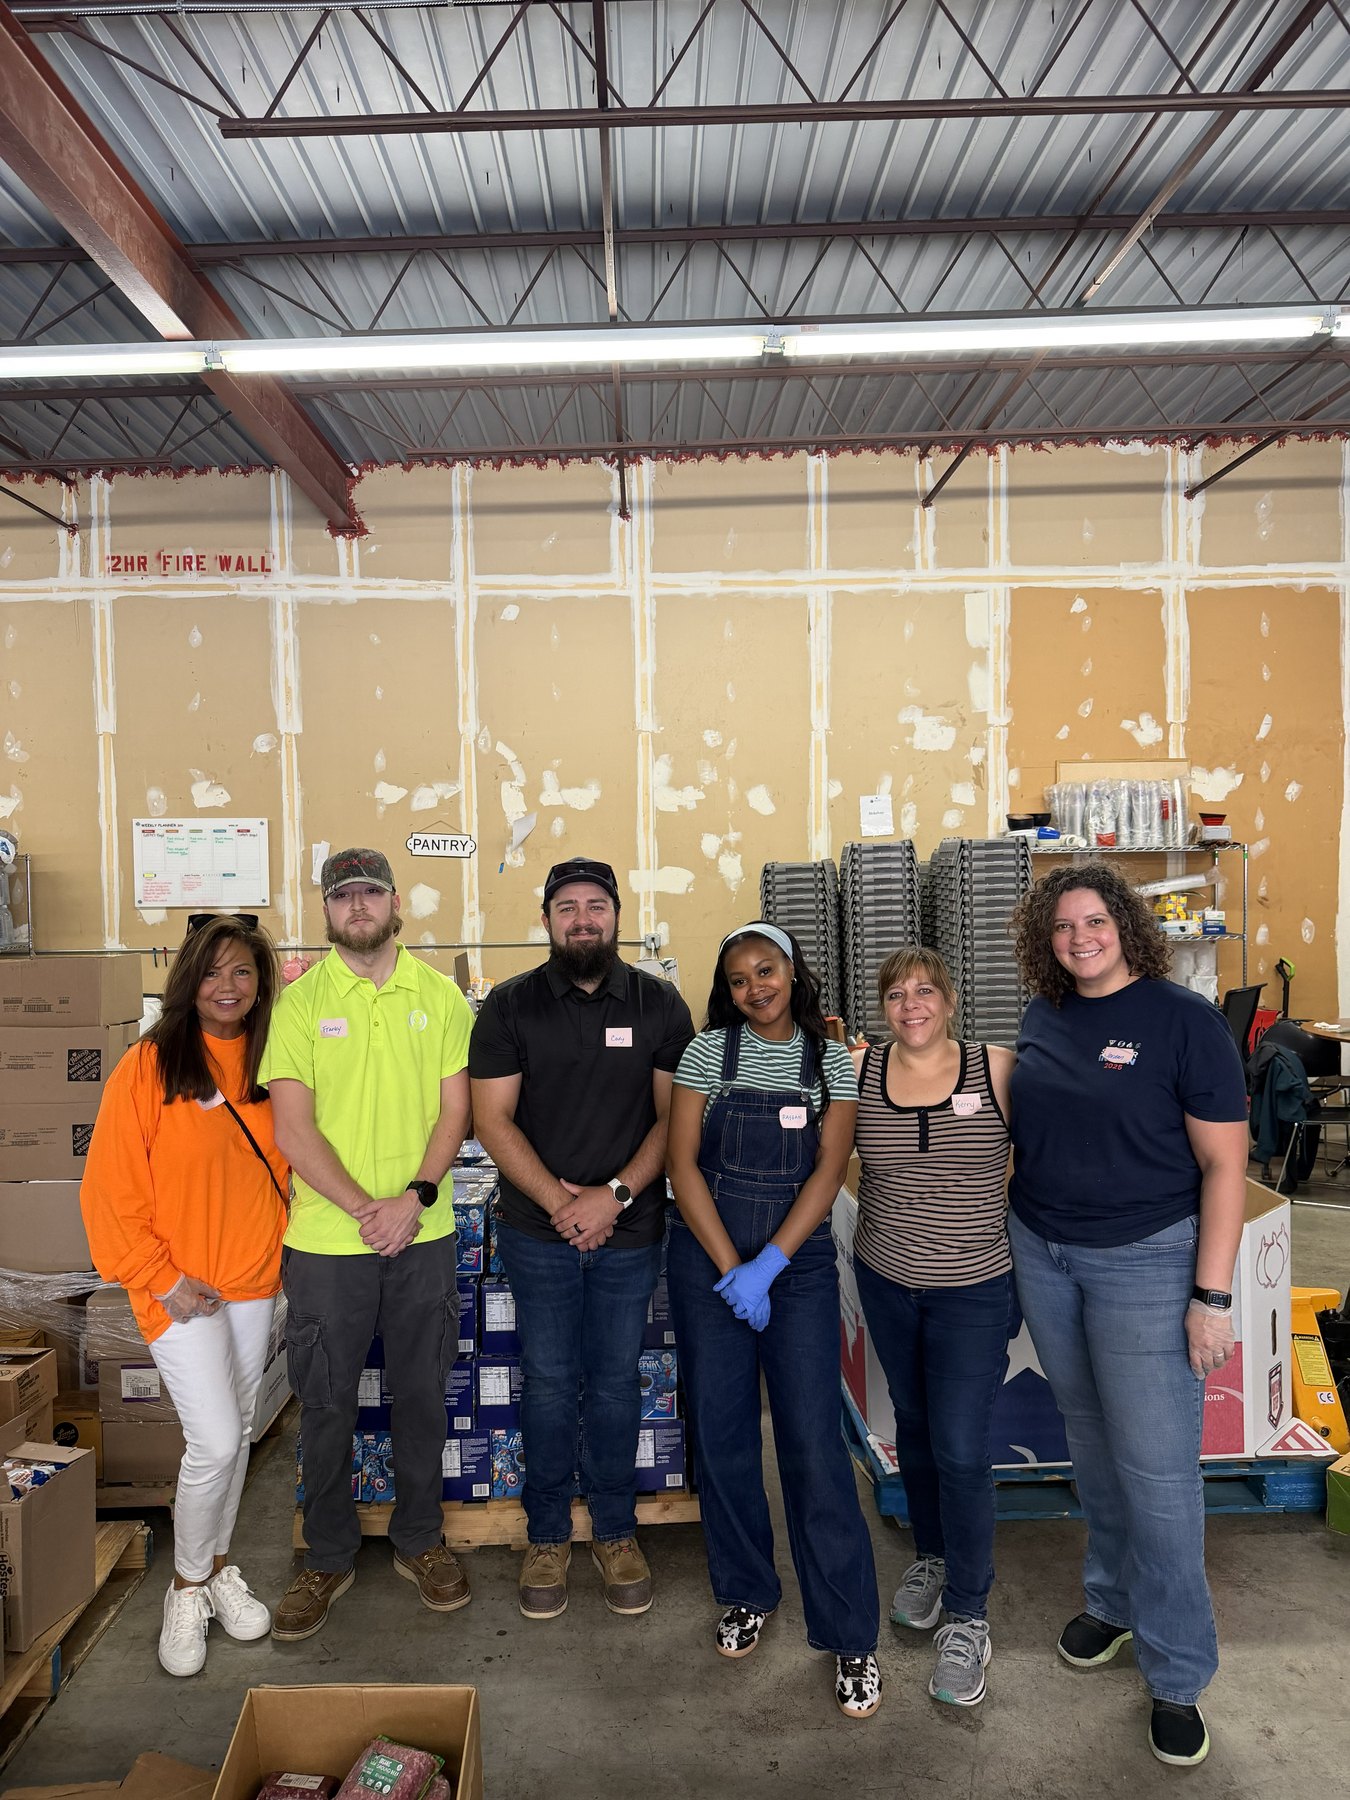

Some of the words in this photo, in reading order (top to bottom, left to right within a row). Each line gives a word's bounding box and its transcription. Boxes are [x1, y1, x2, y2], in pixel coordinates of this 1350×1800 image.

[110, 555, 148, 572] 2HR
[162, 555, 207, 572] FIRE
[218, 555, 272, 573] WALL
[412, 838, 469, 852] PANTRY
